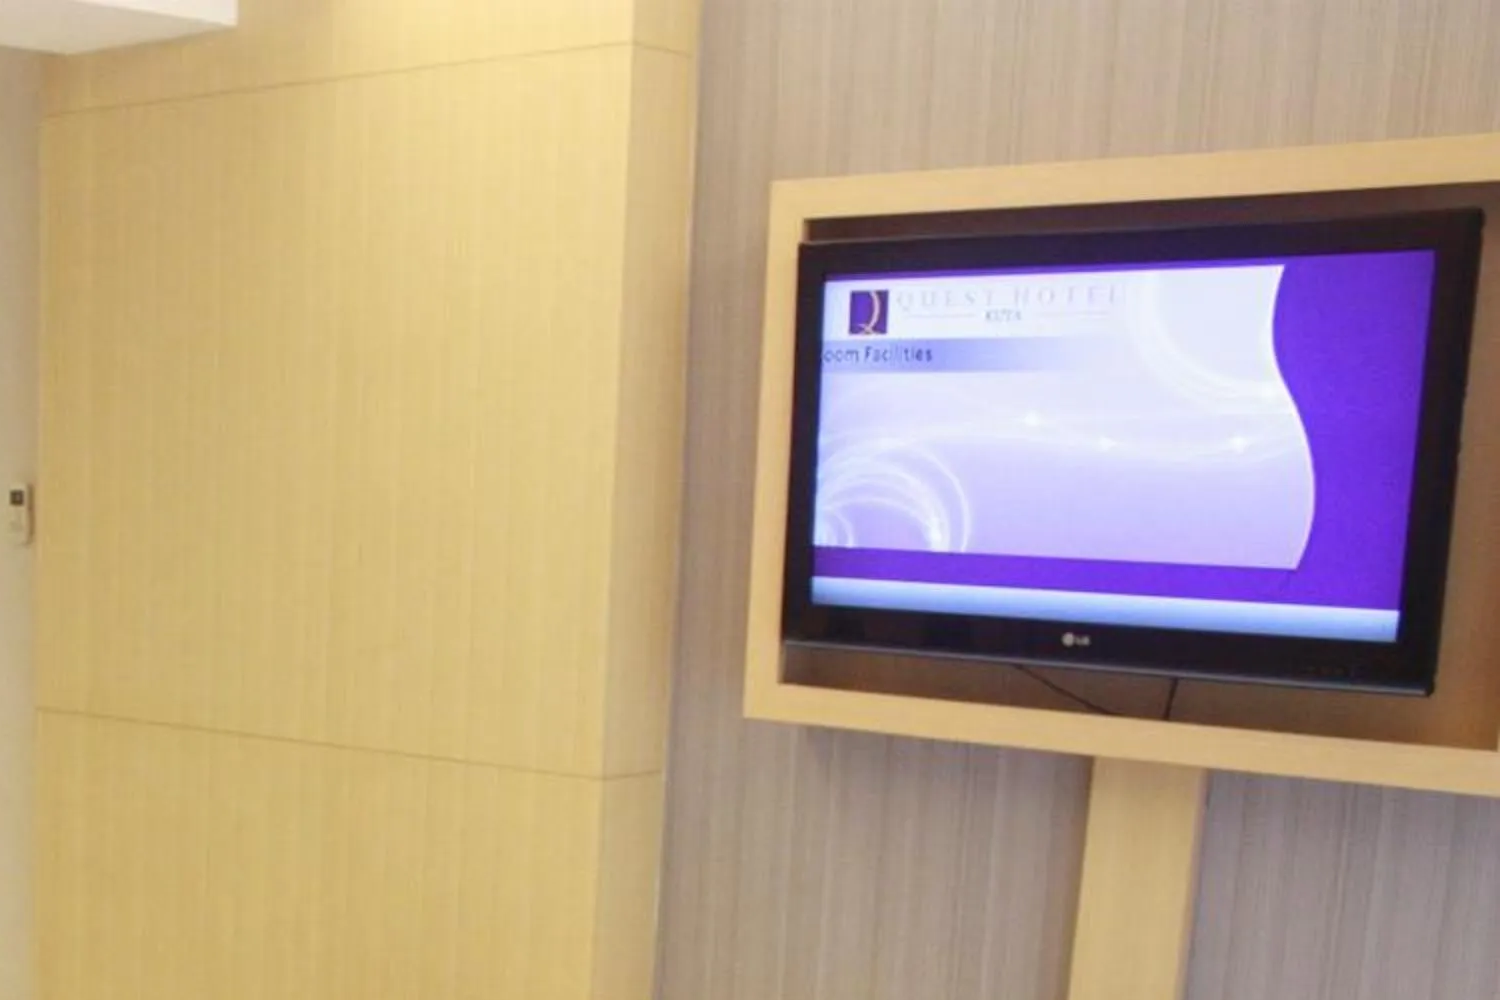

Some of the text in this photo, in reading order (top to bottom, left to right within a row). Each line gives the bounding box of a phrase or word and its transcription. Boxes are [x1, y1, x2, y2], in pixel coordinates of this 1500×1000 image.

[897, 284, 1126, 312] QUEST HOTEL
[864, 346, 933, 363] Facilities
